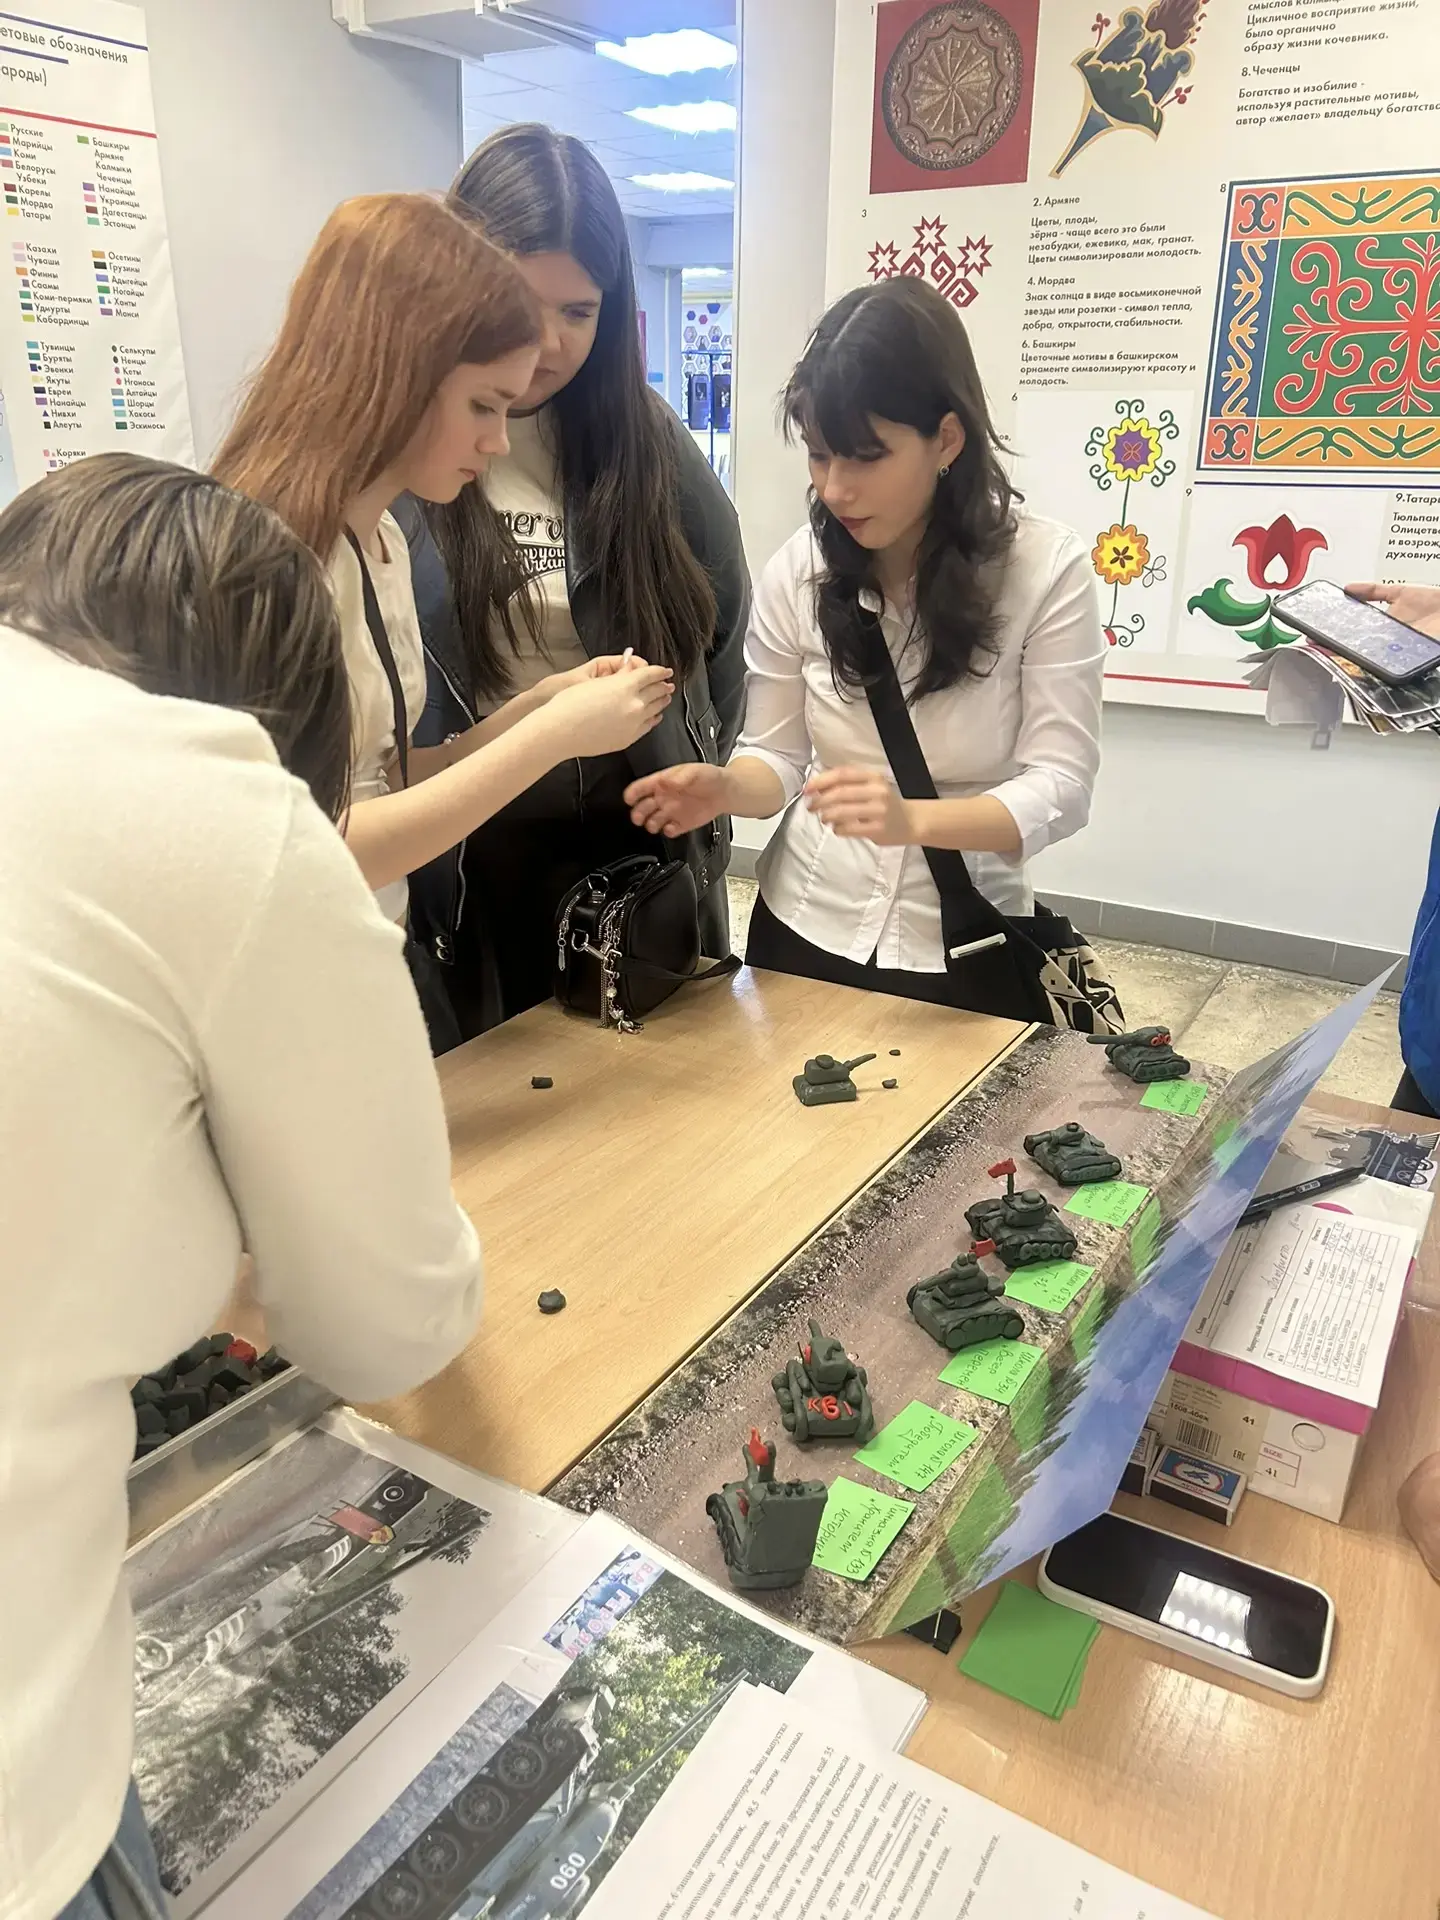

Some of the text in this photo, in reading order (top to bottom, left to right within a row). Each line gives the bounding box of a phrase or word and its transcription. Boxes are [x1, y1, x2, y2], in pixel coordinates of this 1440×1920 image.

[1247, 0, 1419, 26] Цикличное восприятие жизни,
[1245, 23, 1336, 39] было органично
[0, 27, 129, 64] етовые обозначения
[1244, 33, 1388, 54] образу жизни кочевника.
[1, 66, 47, 87] ароды)
[1239, 88, 1290, 98] Богатство
[1303, 80, 1357, 93] изобилие
[1237, 91, 1419, 112] используя растительные мотивы,
[1236, 117, 1266, 126] автор
[1269, 113, 1321, 122] «желает»
[1324, 107, 1383, 119] владельцу
[10, 123, 43, 137] Русские
[12, 136, 53, 151] Марийцы
[92, 137, 130, 152] Башкиры
[13, 148, 36, 160] Коми
[94, 149, 124, 161] Армяне
[15, 160, 56, 175] Белорусы
[95, 160, 132, 173] Калмыки
[16, 172, 47, 185] Узбеки
[96, 172, 132, 185] Чеченцы
[18, 185, 51, 197] Карелы
[98, 183, 135, 197] Нанайцы
[1220, 183, 1226, 193] 8
[20, 196, 53, 209] Мордва
[99, 194, 140, 208] Украинцы
[1044, 196, 1080, 208] Армяне
[21, 208, 51, 222] Татары
[102, 206, 147, 220] Дагестанцы
[103, 218, 136, 230] Эстонцы
[1031, 217, 1098, 228] Цветы, плоды,
[1030, 230, 1058, 241] зёрна
[1066, 229, 1091, 237] чаще
[1140, 222, 1165, 232] были
[26, 243, 57, 254] Казахи
[1029, 236, 1194, 252] незабудки, ежевика, мак, гранат.
[27, 255, 60, 266] Чуваши
[108, 251, 141, 262] Осетины
[1028, 249, 1201, 265] Цветы символизировали молодость.
[30, 268, 58, 279] Финны
[109, 262, 140, 273] Грузины
[31, 279, 59, 290] Саамы
[112, 275, 148, 287] Адыгейцы
[1038, 276, 1075, 287] Мордва
[33, 291, 92, 304] Коми-пермяки
[113, 286, 145, 298] Ногайцы
[1025, 292, 1048, 301] Знак
[1050, 293, 1084, 301] солнца
[1093, 292, 1116, 300] виде
[1118, 286, 1202, 298] восьмиконечной
[114, 297, 136, 307] Ханты
[34, 303, 70, 315] Удмурты
[115, 308, 139, 318] Манси
[1024, 308, 1056, 316] звезды
[1077, 306, 1116, 316] розетки
[36, 314, 89, 327] Кабардинцы
[1022, 320, 1054, 332] добра,
[1032, 339, 1076, 350] Башкиры
[1021, 353, 1070, 363] Цветочные
[1116, 351, 1178, 362] башкирском
[1020, 367, 1069, 375] орнаменте
[1071, 366, 1145, 374] символизируют
[1147, 365, 1187, 374] красоту
[127, 399, 154, 409] Шорцы
[56, 448, 86, 459] Коряки
[1393, 512, 1439, 522] Тюльпан
[1398, 540, 1440, 549] возрож
[1241, 1415, 1256, 1425] 41
[1265, 1467, 1277, 1478] 41
[549, 1852, 586, 1890] 060
